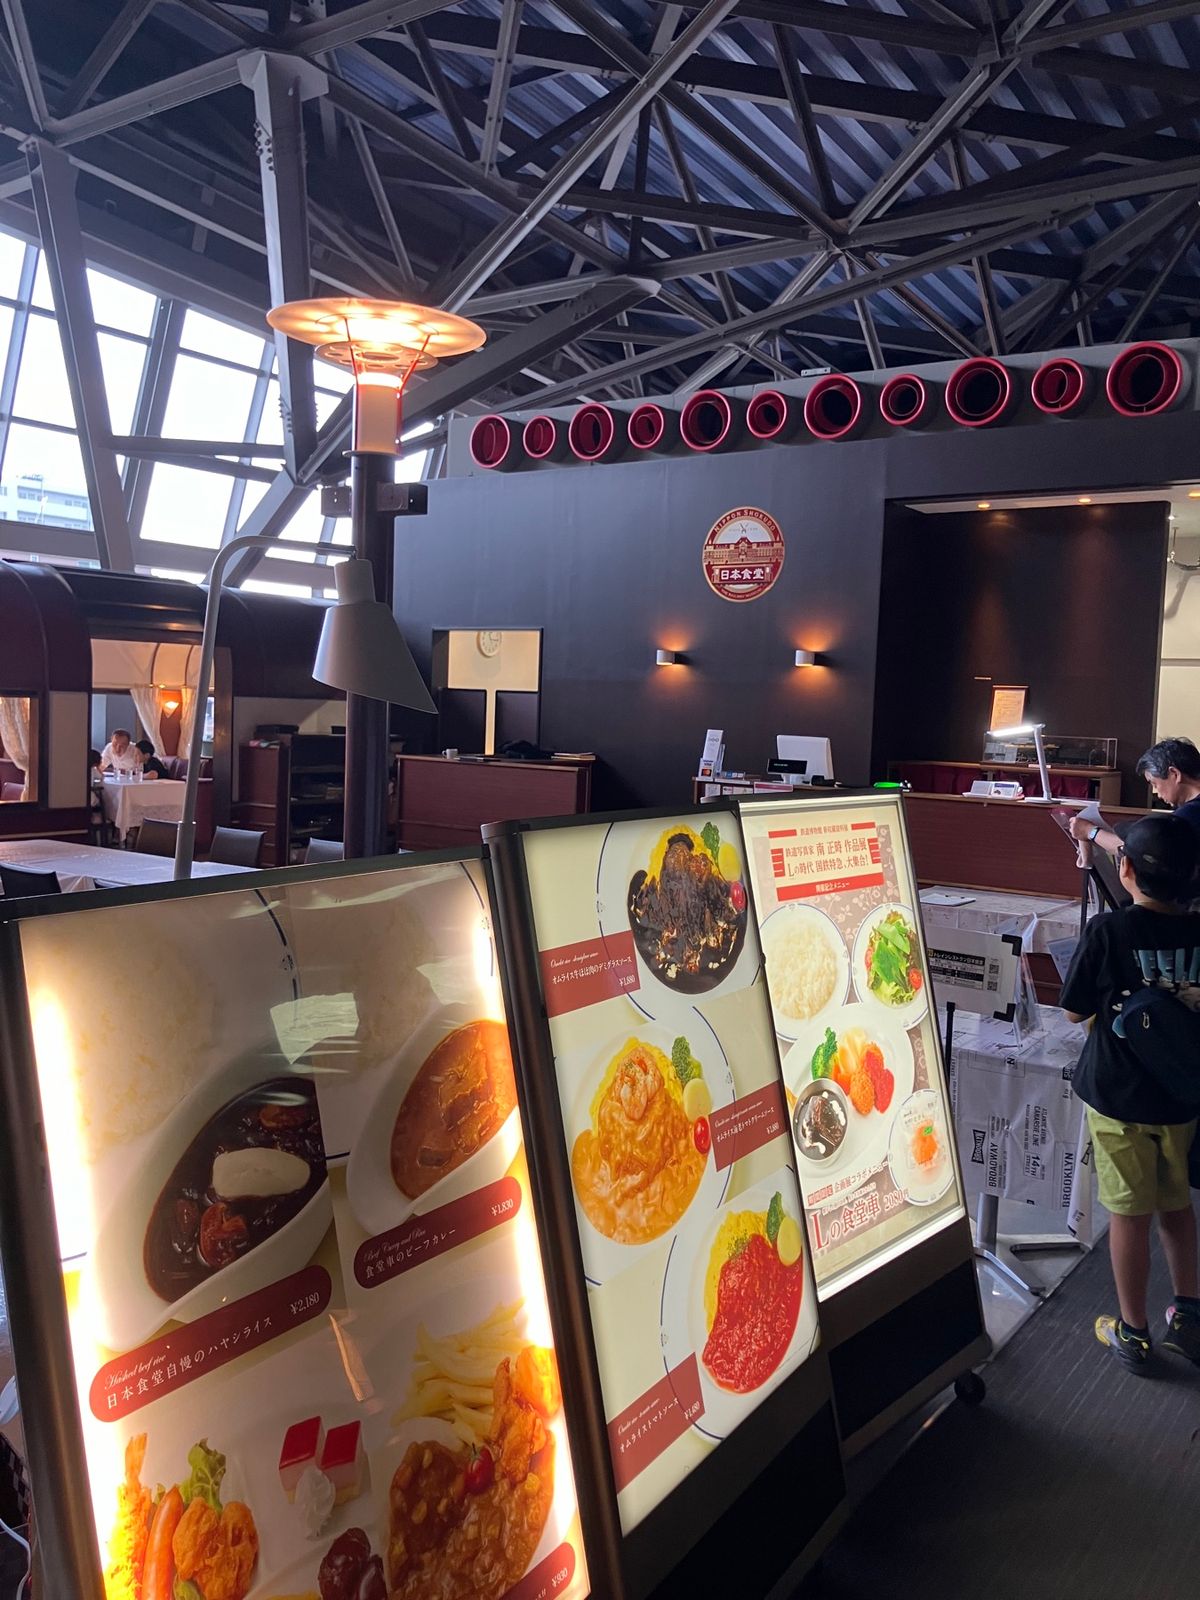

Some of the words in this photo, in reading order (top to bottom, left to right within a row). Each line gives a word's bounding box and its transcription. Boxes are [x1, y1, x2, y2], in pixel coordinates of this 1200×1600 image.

[714, 511, 741, 533] NIPPON
[743, 509, 776, 531] SHOKUDO
[720, 567, 764, 580] 日本食堂
[816, 842, 825, 856] 南
[844, 837, 867, 853] 作品展
[988, 1142, 999, 1188] BROADWAY
[1062, 1152, 1074, 1208] BROOKLYN
[491, 1198, 514, 1217] ¥1,830
[811, 1192, 880, 1250] Lの食堂車
[365, 1229, 456, 1279] 食堂車のビーフカレー
[289, 1291, 321, 1315] ¥2,180
[107, 1316, 273, 1410] 日本食堂自慢のハヤシライス
[137, 1357, 153, 1376] beef
[153, 1353, 167, 1367] rice
